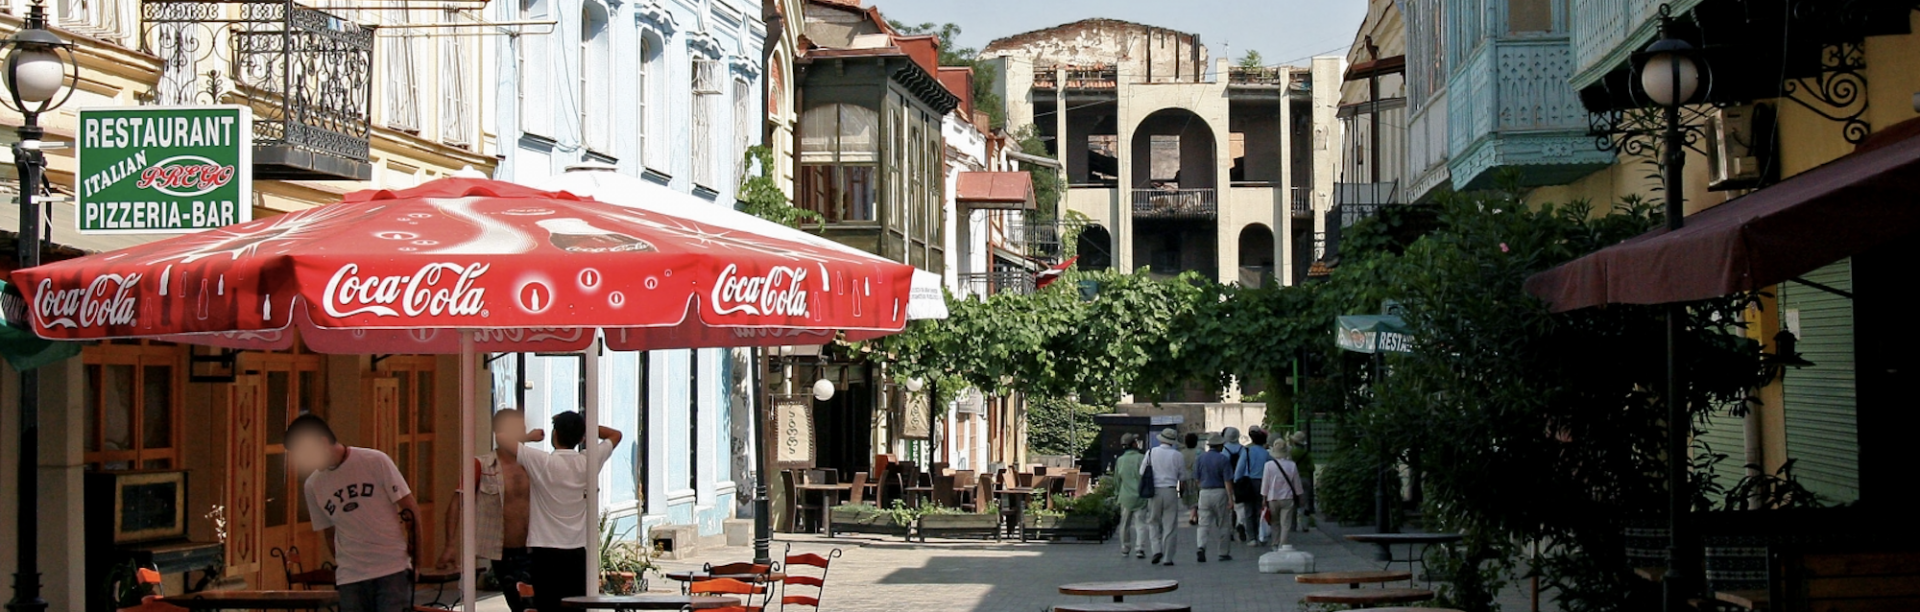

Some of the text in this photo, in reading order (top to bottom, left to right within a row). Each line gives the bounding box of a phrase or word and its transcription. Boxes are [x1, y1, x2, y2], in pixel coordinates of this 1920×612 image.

[85, 116, 235, 148] RESTAURANT
[84, 150, 148, 197] ITALIAN
[136, 164, 235, 190] PREGO
[85, 201, 234, 229] PIZZERIA-BAR
[33, 272, 143, 329] Coca-Cola
[321, 261, 491, 318] Coca-Cola
[711, 262, 808, 318] Coca-Cola
[324, 482, 374, 516] EYED
